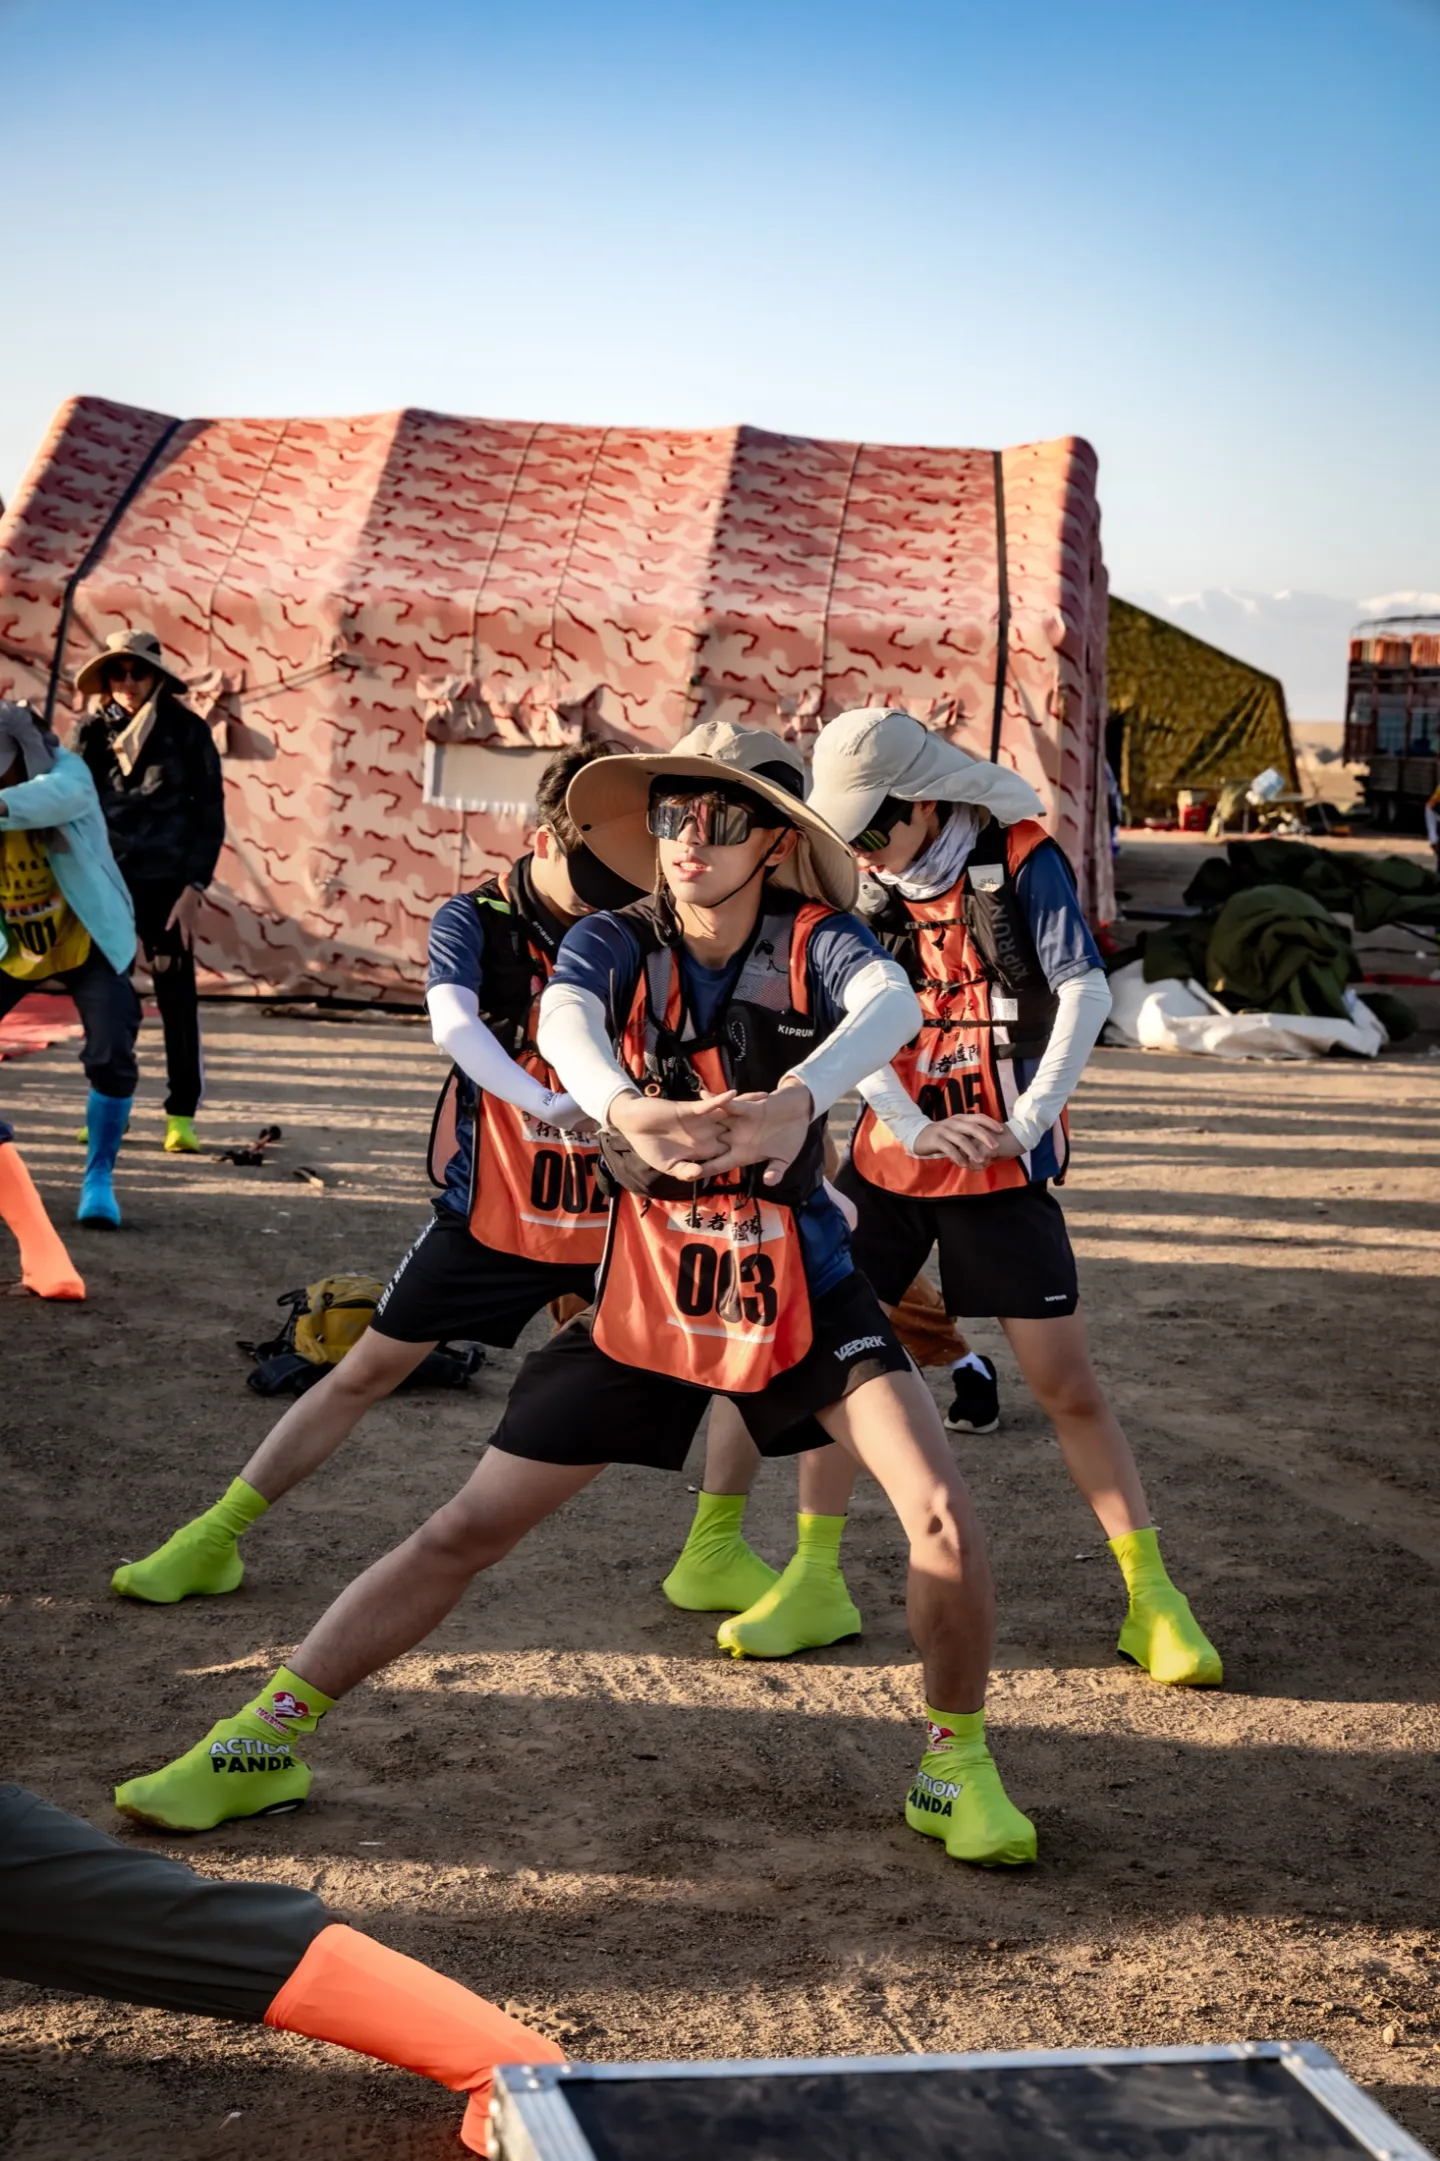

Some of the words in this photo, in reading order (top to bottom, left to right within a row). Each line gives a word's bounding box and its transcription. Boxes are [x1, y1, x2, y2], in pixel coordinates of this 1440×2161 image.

[778, 1024, 814, 1037] KIPRUN
[676, 1242, 778, 1327] 003
[211, 1756, 296, 1774] PANDA
[915, 1771, 962, 1800] CTION
[907, 1786, 953, 1818] ANDA
